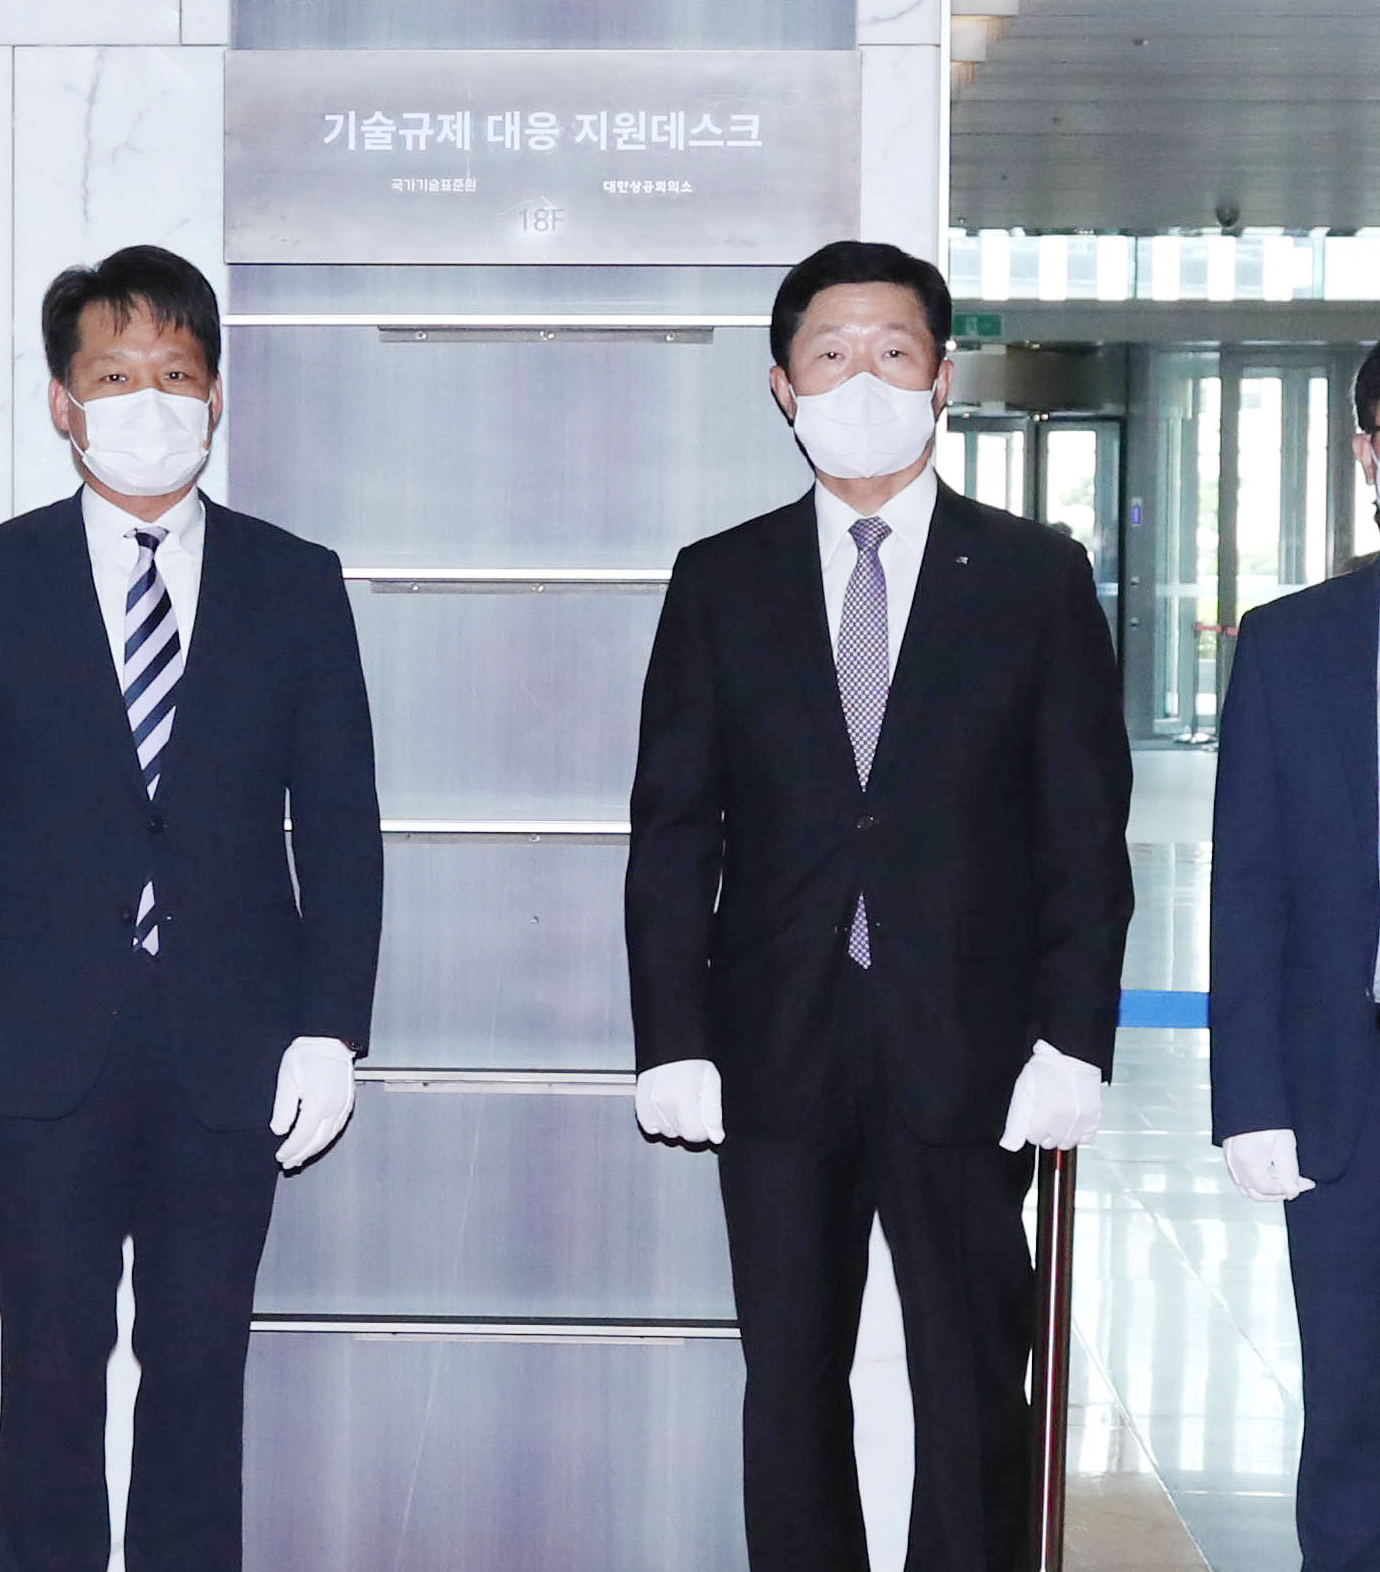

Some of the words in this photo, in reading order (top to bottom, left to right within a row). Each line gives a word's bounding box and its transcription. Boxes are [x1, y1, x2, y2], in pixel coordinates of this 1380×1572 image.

[323, 110, 471, 151] 기술규제
[486, 110, 561, 151] 대응
[574, 110, 763, 151] 지원데스크
[390, 178, 477, 193] 국가기술표준원
[519, 207, 565, 232] 18F
